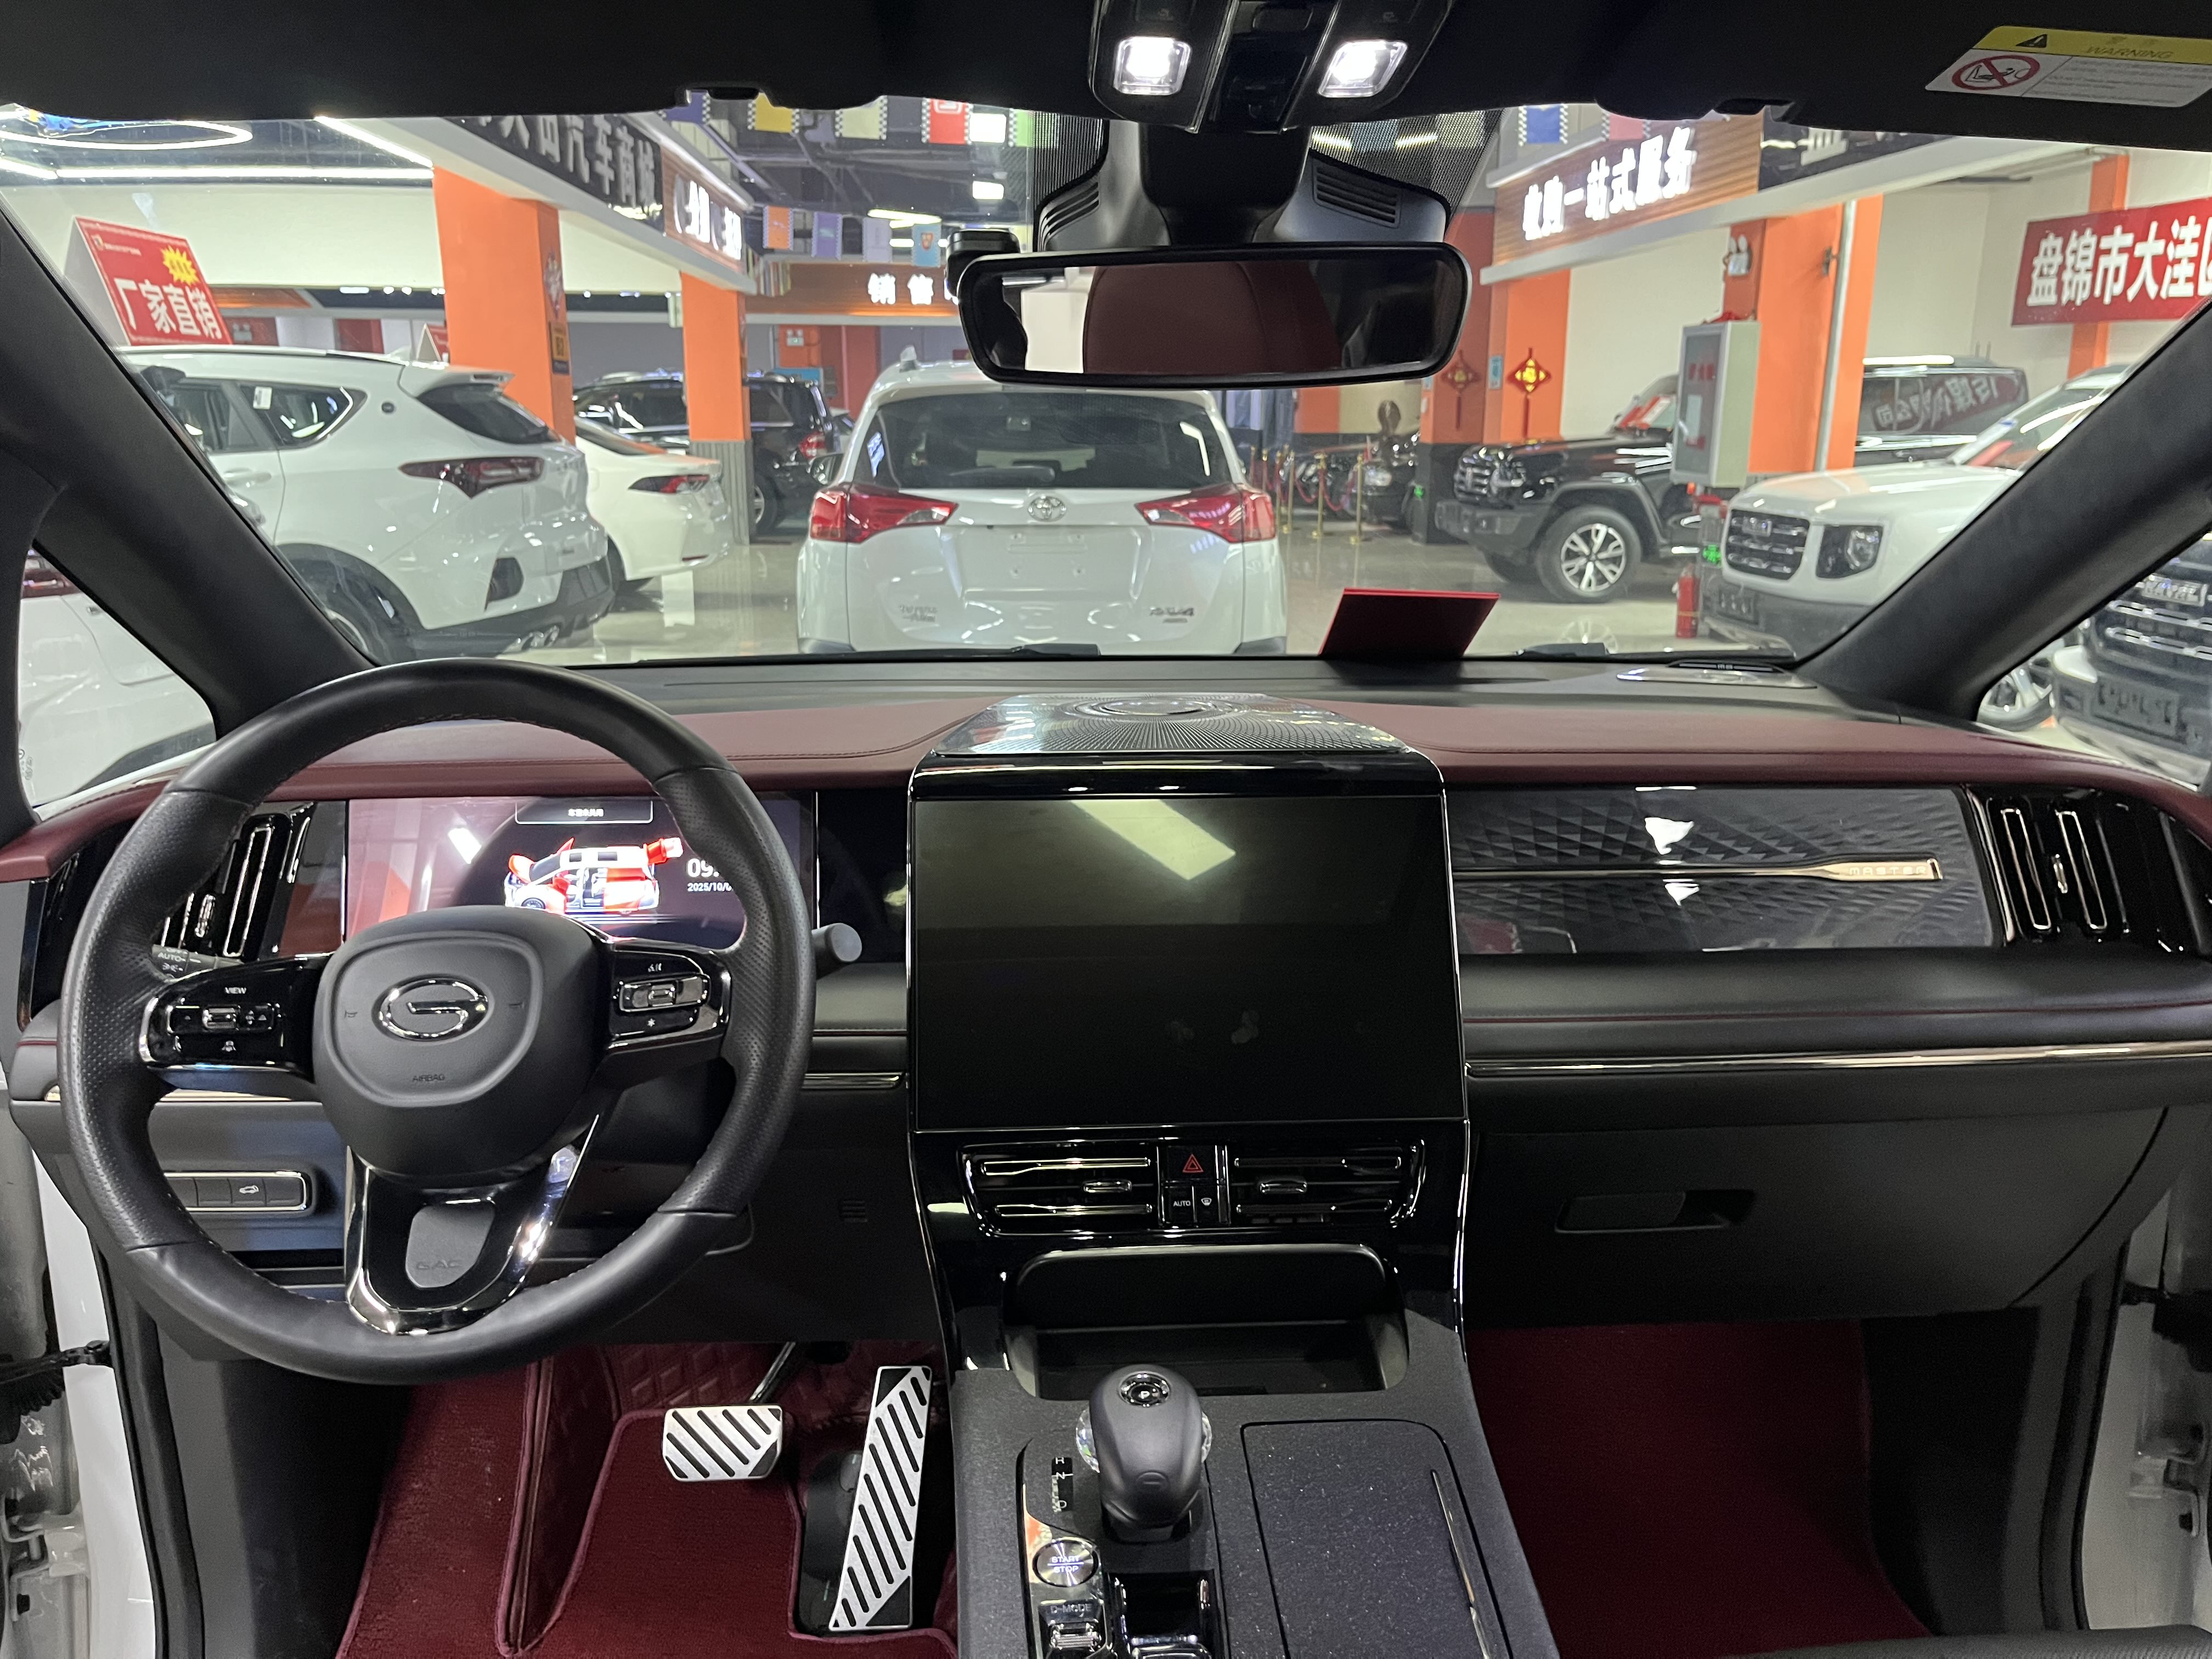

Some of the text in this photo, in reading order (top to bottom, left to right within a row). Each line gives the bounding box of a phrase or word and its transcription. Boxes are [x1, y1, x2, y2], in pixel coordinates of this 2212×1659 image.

[2084, 46, 2175, 59] WARNING
[867, 273, 959, 305] 销售
[114, 277, 222, 339] 厂家直销
[1849, 866, 1926, 876] MASTER
[157, 952, 182, 962] AUTO
[1141, 1391, 1150, 1399] P
[1058, 1500, 1067, 1509] D
[1051, 1555, 1081, 1563] START
